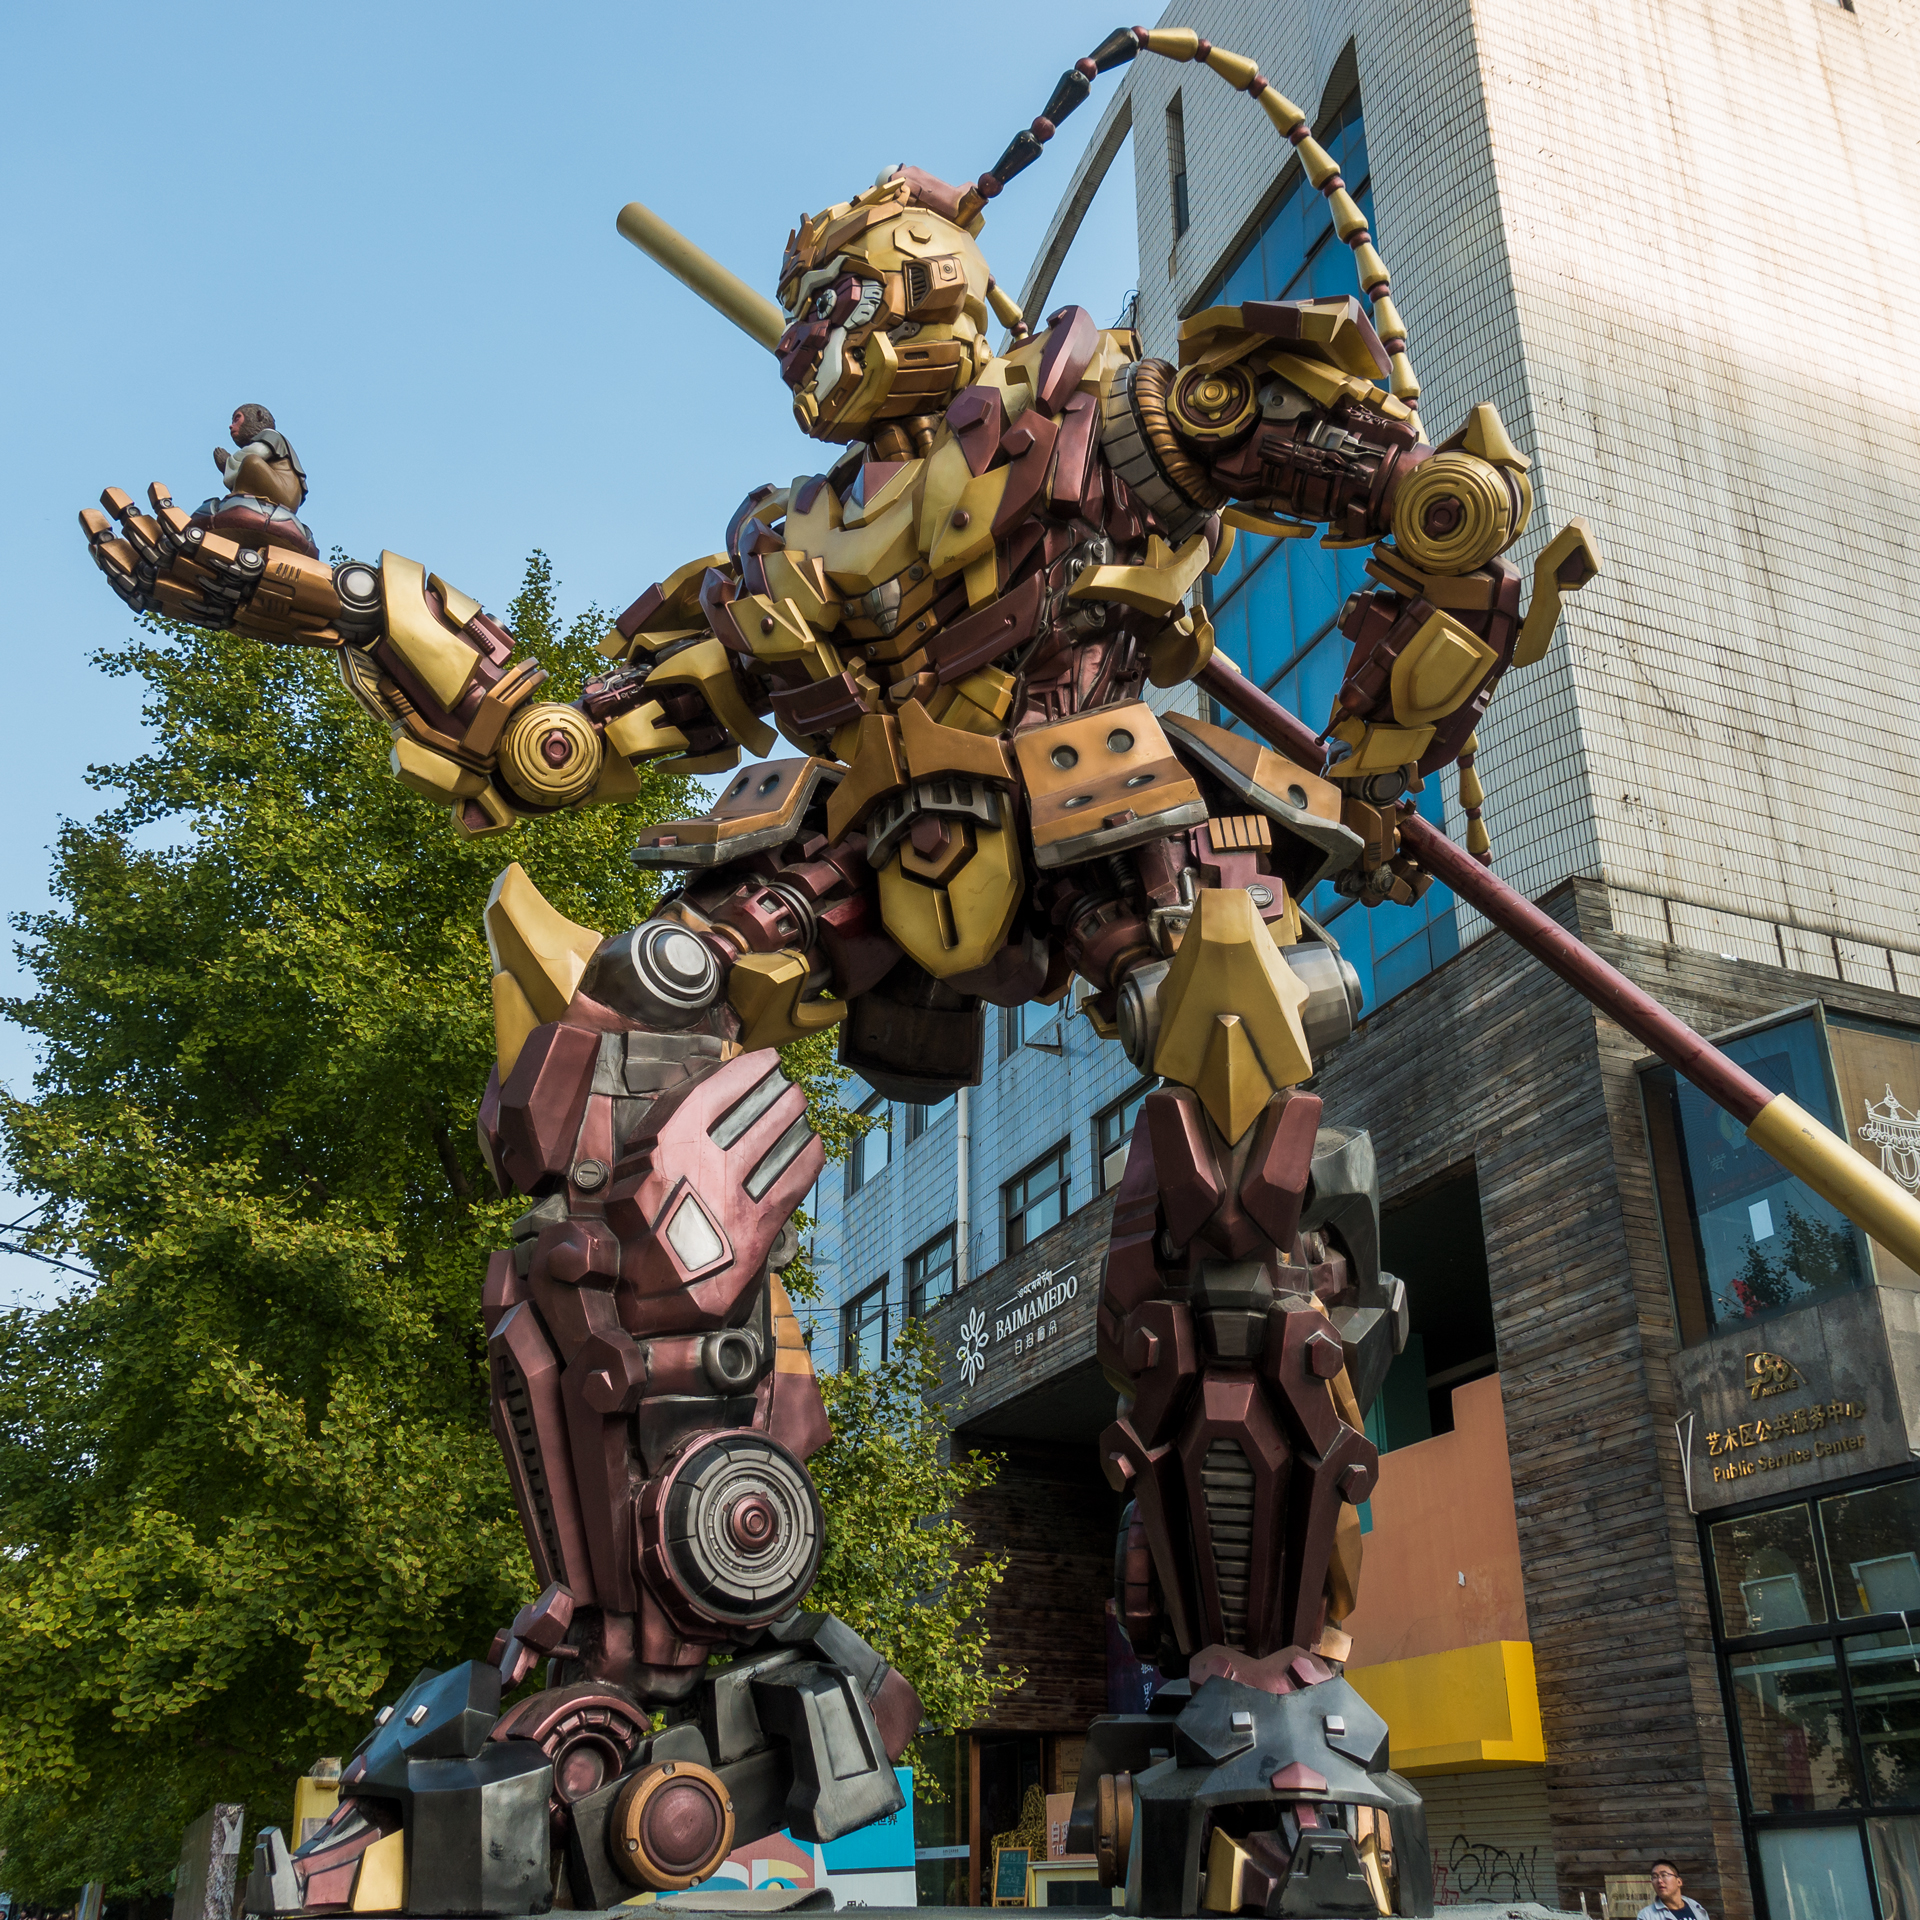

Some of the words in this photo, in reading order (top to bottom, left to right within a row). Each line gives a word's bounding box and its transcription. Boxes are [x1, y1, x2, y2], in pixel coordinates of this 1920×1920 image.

[996, 1276, 1078, 1342] BAIMAMEDO
[1705, 1399, 1867, 1456] 艺术区公共服务中心
[1713, 1460, 1756, 1482] Public
[1758, 1447, 1811, 1471] Service
[1814, 1434, 1865, 1457] Center
